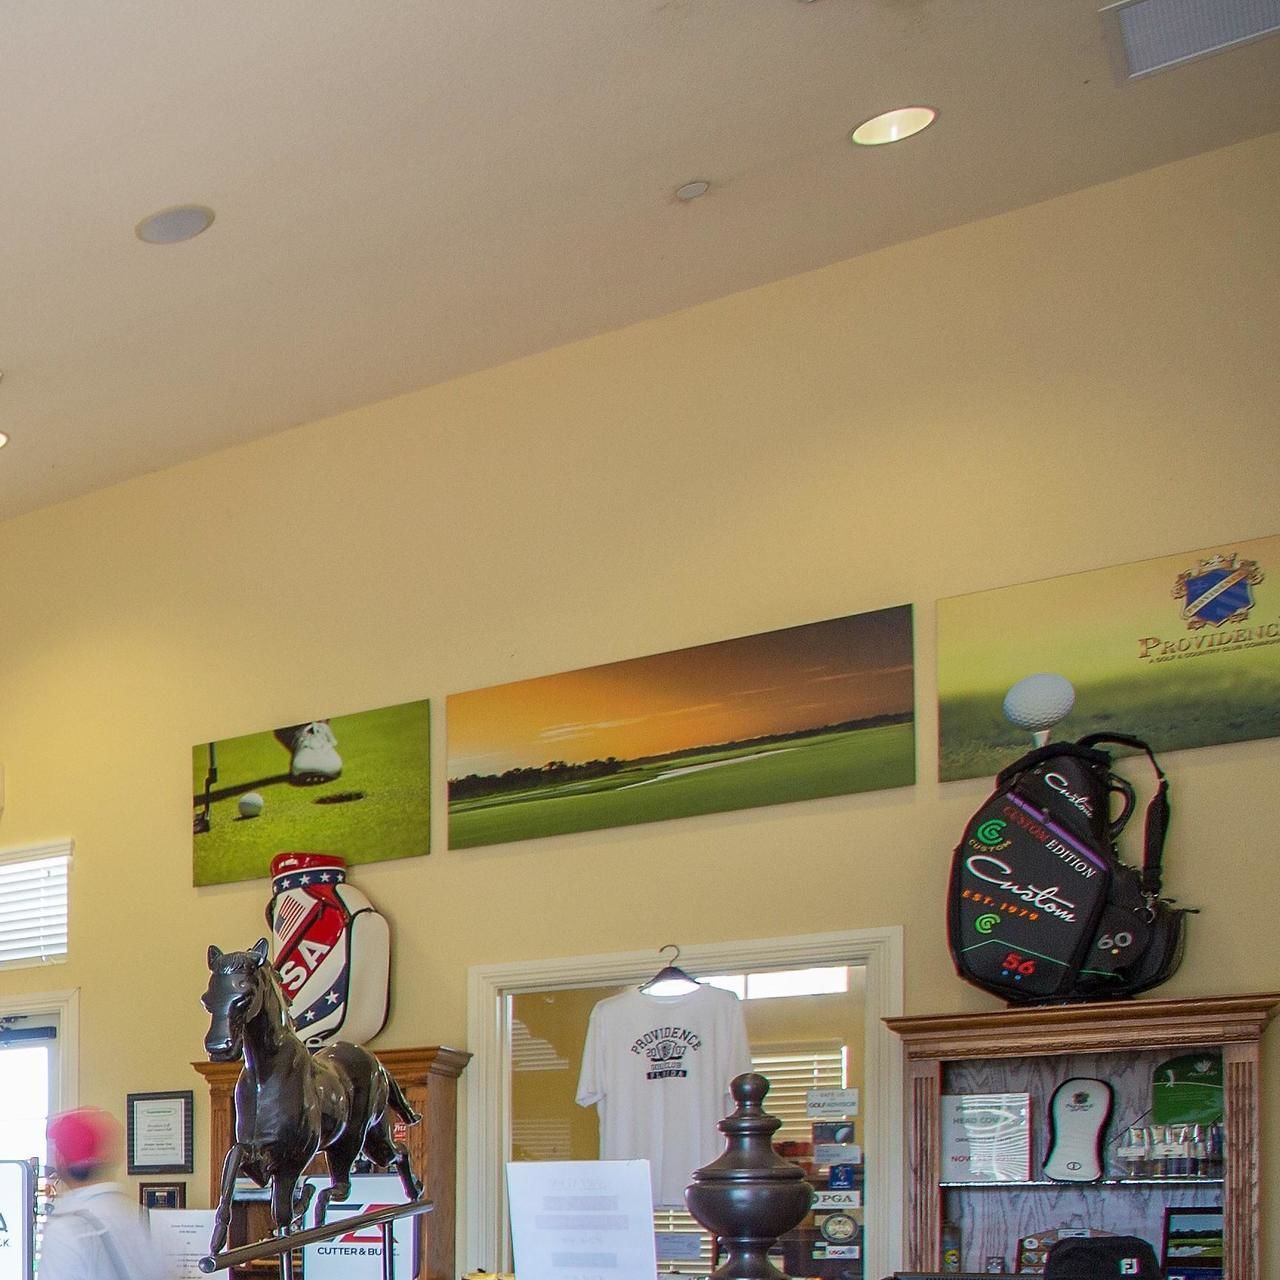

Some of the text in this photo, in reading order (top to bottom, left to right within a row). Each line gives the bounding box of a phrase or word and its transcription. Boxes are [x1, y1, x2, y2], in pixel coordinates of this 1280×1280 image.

[1137, 616, 1280, 659] PROVIDENC
[1044, 773, 1093, 818] Custom
[969, 838, 1012, 853] CUSTOM
[1045, 839, 1096, 879] EDITION
[967, 855, 1077, 922] Custom
[961, 888, 1039, 921] EST. 1979
[1097, 932, 1132, 949] 60
[280, 940, 331, 991] SA
[1002, 952, 1036, 975] 56
[631, 1027, 702, 1054] PROVIDENCE
[822, 1194, 853, 1203] PGA
[317, 1247, 357, 1256] CUTTER
[359, 1247, 366, 1256] &
